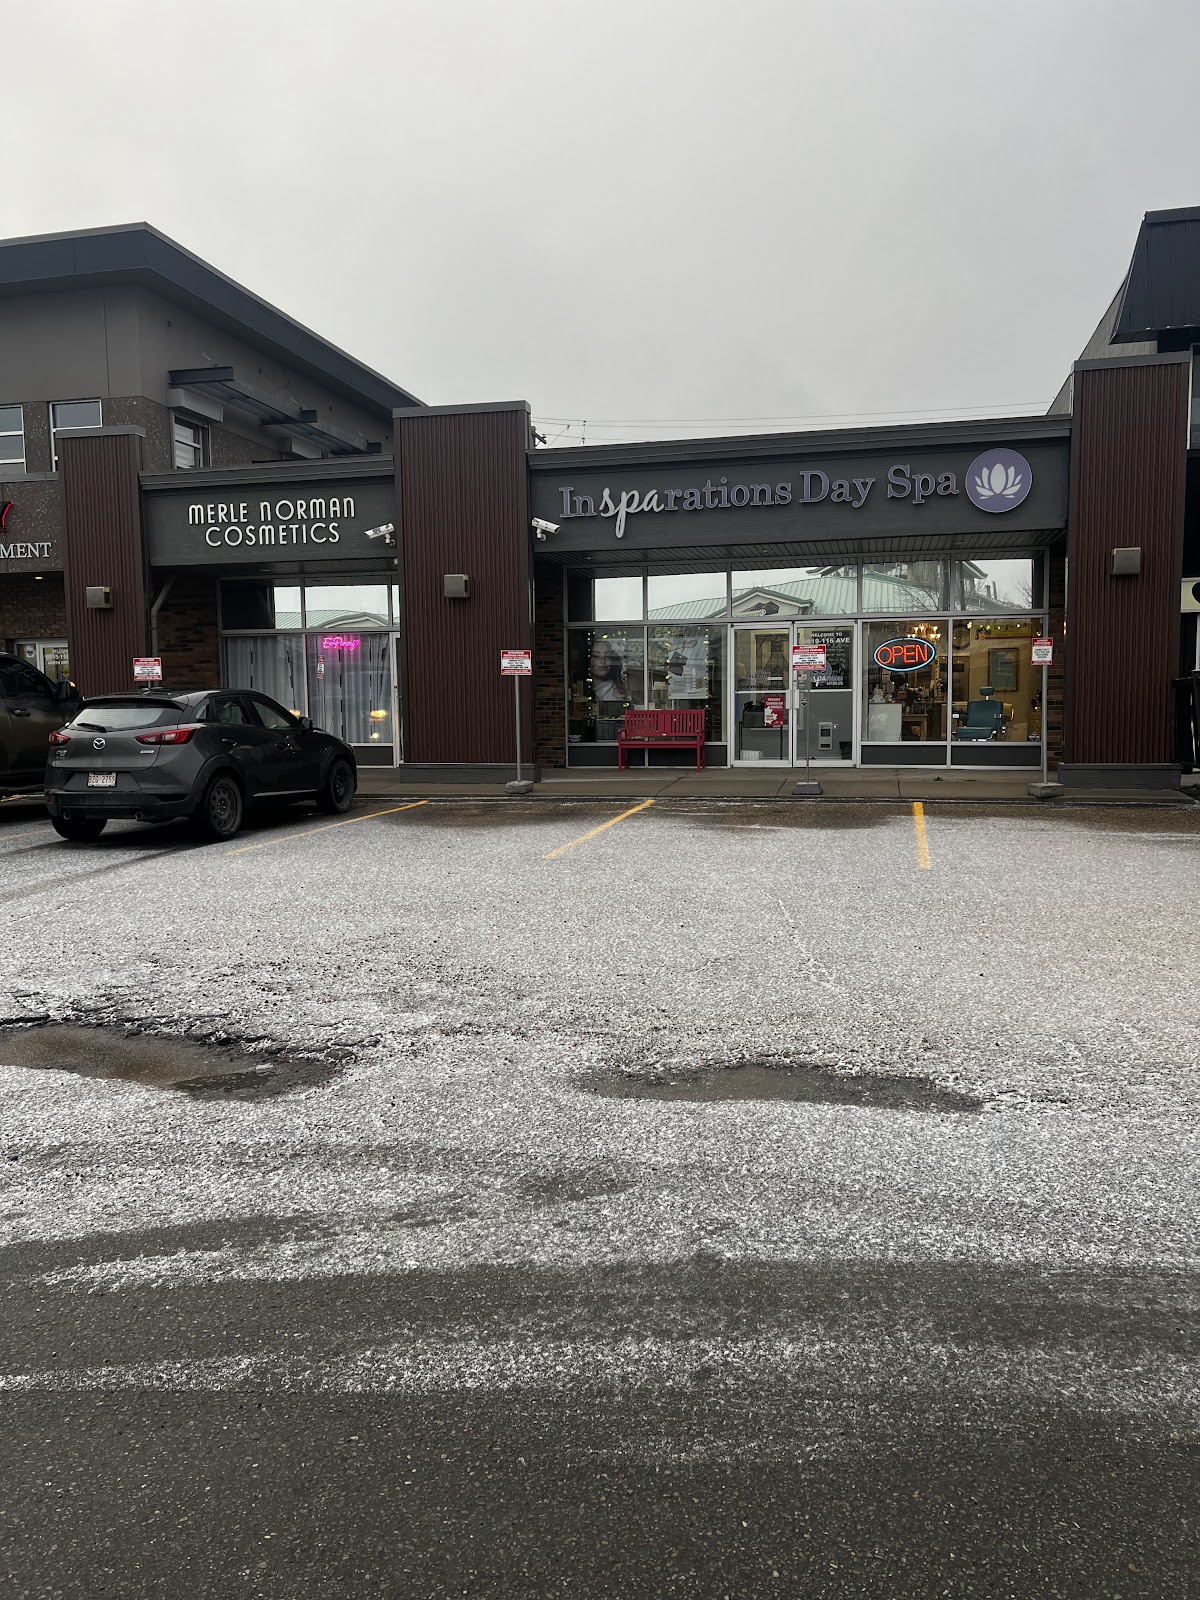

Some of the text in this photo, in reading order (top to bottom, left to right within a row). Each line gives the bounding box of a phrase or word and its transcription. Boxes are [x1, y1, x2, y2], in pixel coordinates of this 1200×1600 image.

[188, 497, 355, 525] MERLE NORMAN
[558, 464, 960, 538] Insparations Day Spa
[205, 522, 340, 547] COSMETICS
[0, 542, 52, 559] MENT
[877, 644, 928, 665] OPEN
